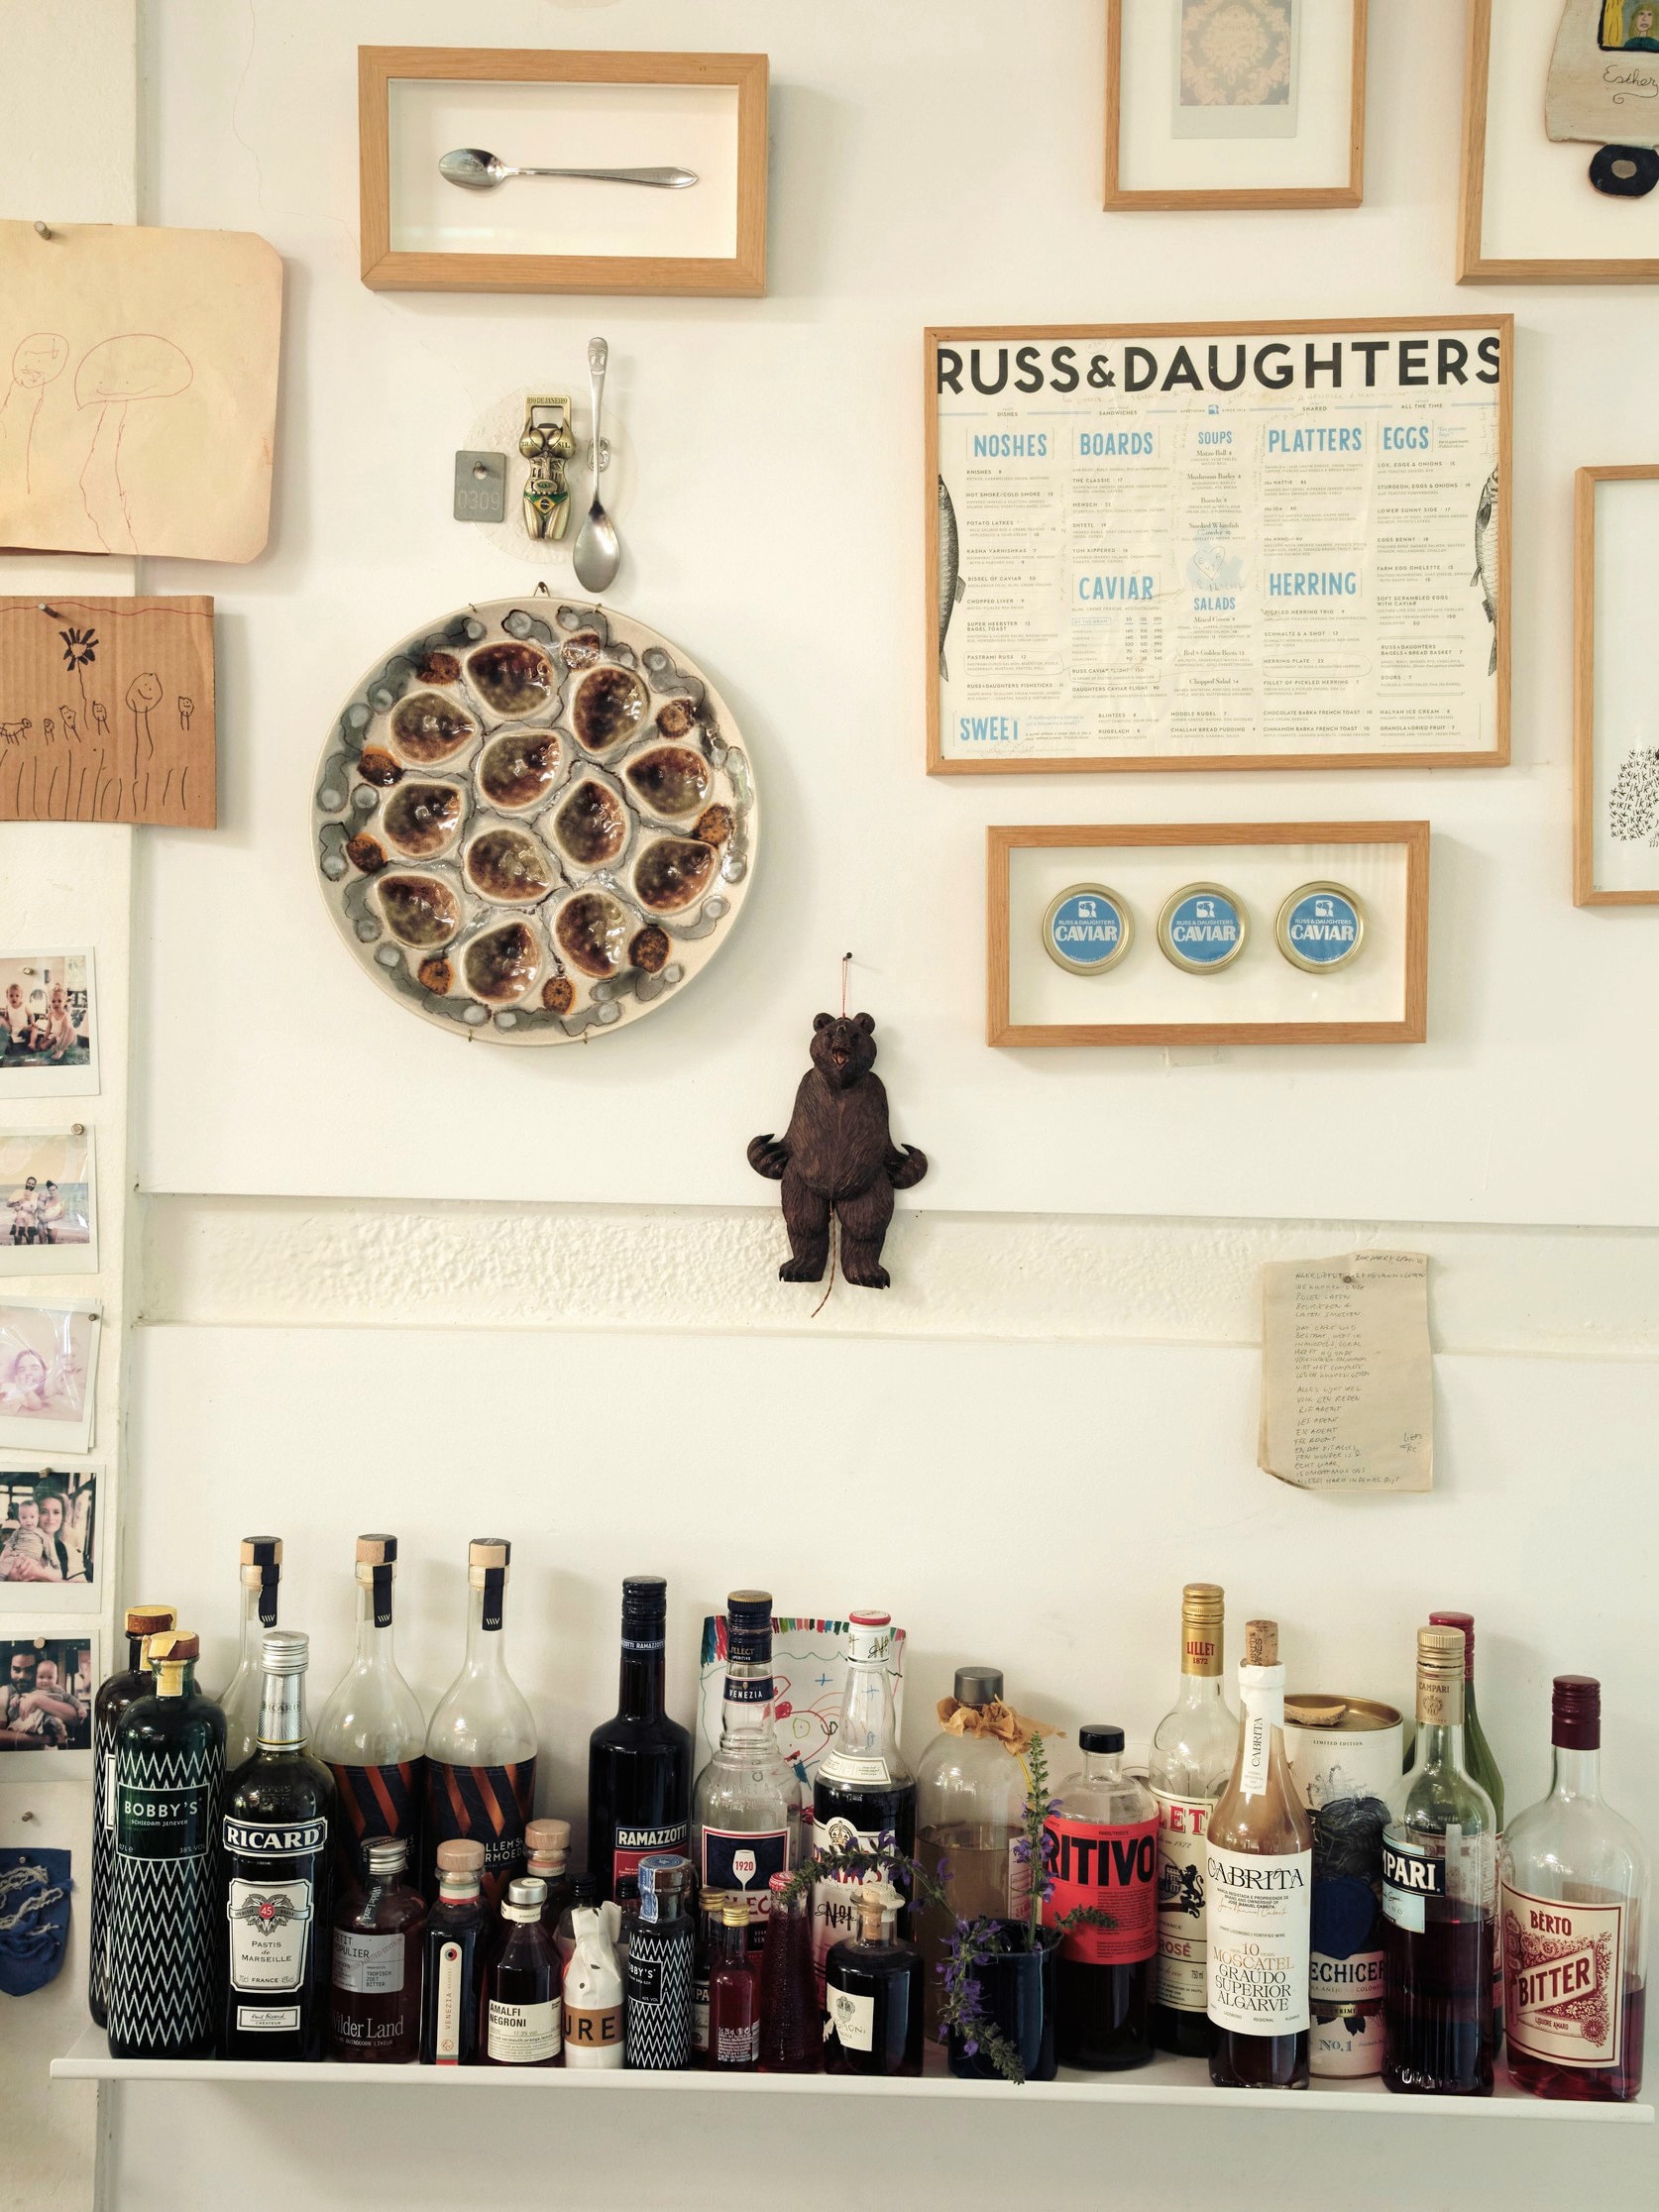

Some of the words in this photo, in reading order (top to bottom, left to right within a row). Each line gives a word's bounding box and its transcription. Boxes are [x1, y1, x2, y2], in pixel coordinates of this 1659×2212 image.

[1603, 64, 1658, 98] Esther
[973, 433, 1048, 458] NOSHES
[1079, 431, 1154, 457] BOARDS
[1197, 430, 1233, 445] SOUPS
[1269, 427, 1362, 453] PLATTERS
[1383, 425, 1429, 450] EGGS
[458, 491, 500, 510] 0309
[1078, 576, 1154, 601] CAVIAR
[1270, 572, 1357, 597] HERRING
[1193, 597, 1236, 611] SALADS
[1054, 926, 1118, 941] CAVIAR
[1172, 926, 1237, 942] CAVIAR
[1290, 925, 1355, 941] CAVIAR
[1186, 1641, 1215, 1656] LILLET
[728, 1689, 763, 1700] VENEZIA
[1418, 1682, 1450, 1694] CAMPARI
[1251, 1717, 1264, 1767] CABRITA
[124, 1800, 198, 1818] BOBBY'S
[226, 1825, 320, 1849] RICARD
[618, 1824, 687, 1846] RAMAZZOTTI
[734, 1860, 754, 1872] 1920
[1207, 1857, 1305, 1891] CABRITA
[261, 1906, 273, 1916] 45
[1529, 1909, 1573, 1937] BÈRTO
[1213, 1946, 1294, 1970] MOSCATEL
[1243, 1942, 1260, 1956] 10
[1219, 1963, 1286, 1985] GRAÚDO
[1518, 1956, 1592, 2008] BITTER
[1215, 1974, 1291, 1998] SUPERIOR
[490, 2003, 520, 2017] AMALFI
[1218, 1990, 1289, 2012] ALGARVE
[366, 2014, 404, 2039] Land
[490, 2013, 526, 2028] NEGRONI
[1534, 2016, 1552, 2028] LIQUORE
[1553, 2021, 1569, 2031] AMARO
